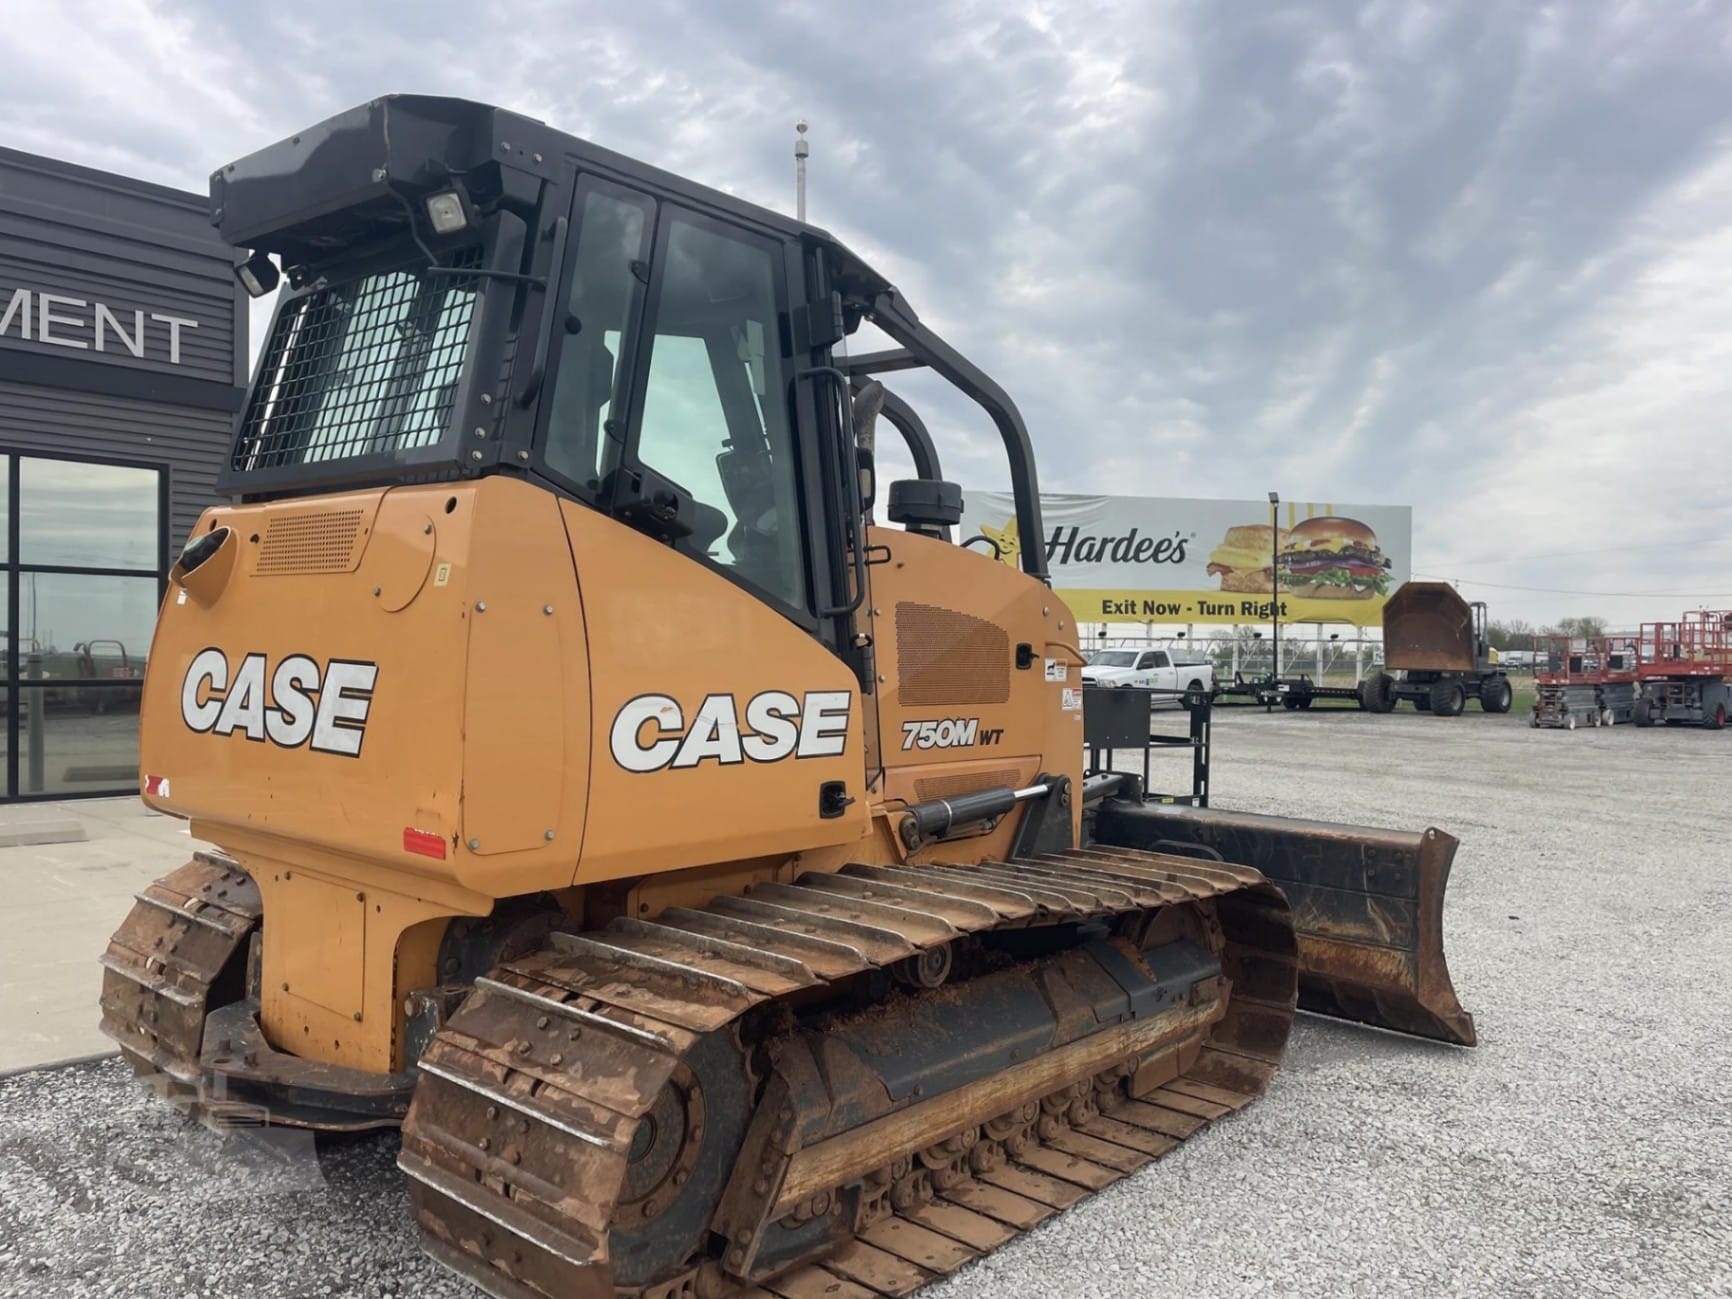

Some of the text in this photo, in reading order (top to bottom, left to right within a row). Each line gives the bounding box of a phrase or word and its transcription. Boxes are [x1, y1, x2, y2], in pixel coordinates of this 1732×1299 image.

[1045, 526, 1188, 564] Hardee's
[1102, 599, 1136, 615] Exit
[1143, 600, 1181, 615] Now
[1197, 601, 1235, 616] Turn
[1240, 601, 1288, 619] Right
[181, 647, 379, 758] CASE
[609, 690, 852, 773] CASE
[901, 717, 1004, 751] 750M WT
